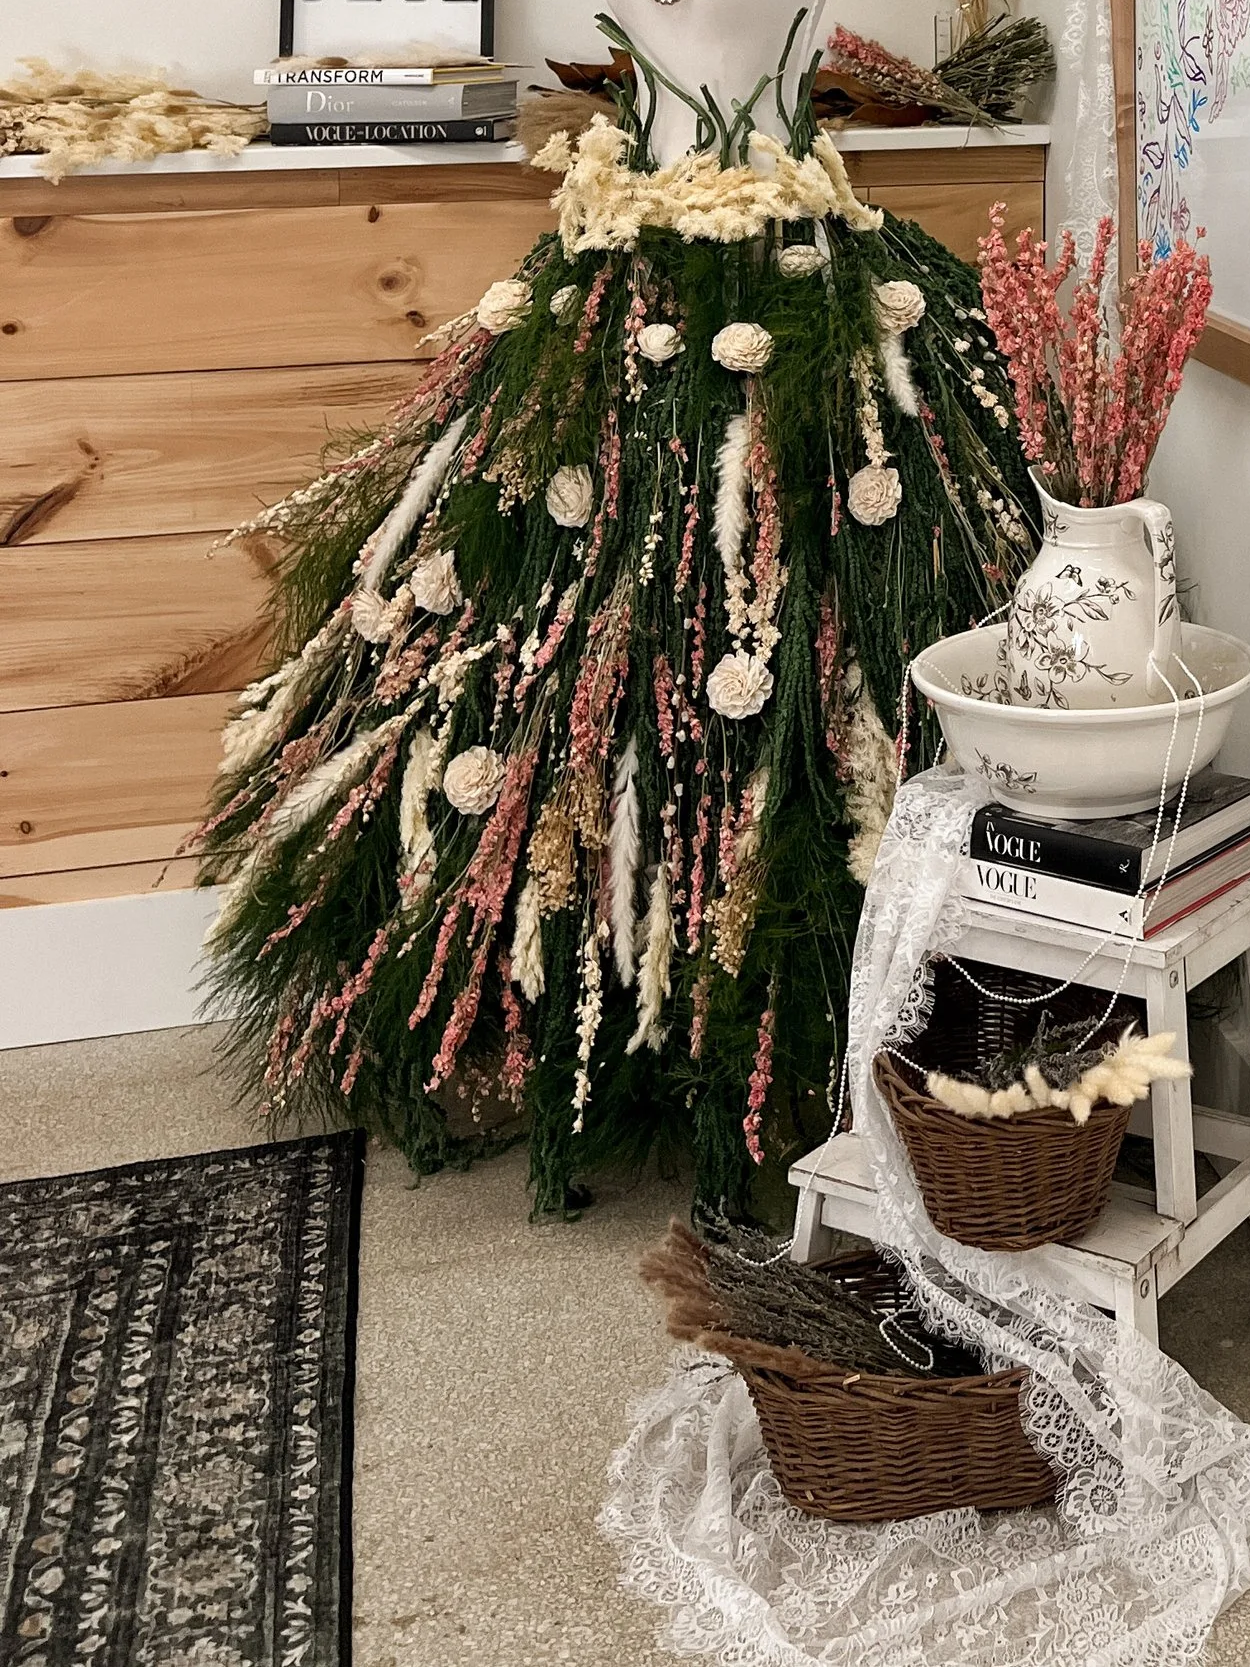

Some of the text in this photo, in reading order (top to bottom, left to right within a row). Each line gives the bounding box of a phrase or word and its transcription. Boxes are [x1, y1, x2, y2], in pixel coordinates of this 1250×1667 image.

[305, 90, 354, 113] Dior
[305, 124, 448, 142] VOGUE LOCATION
[985, 830, 1041, 863] VOGUE
[976, 864, 1037, 900] VOGUE
